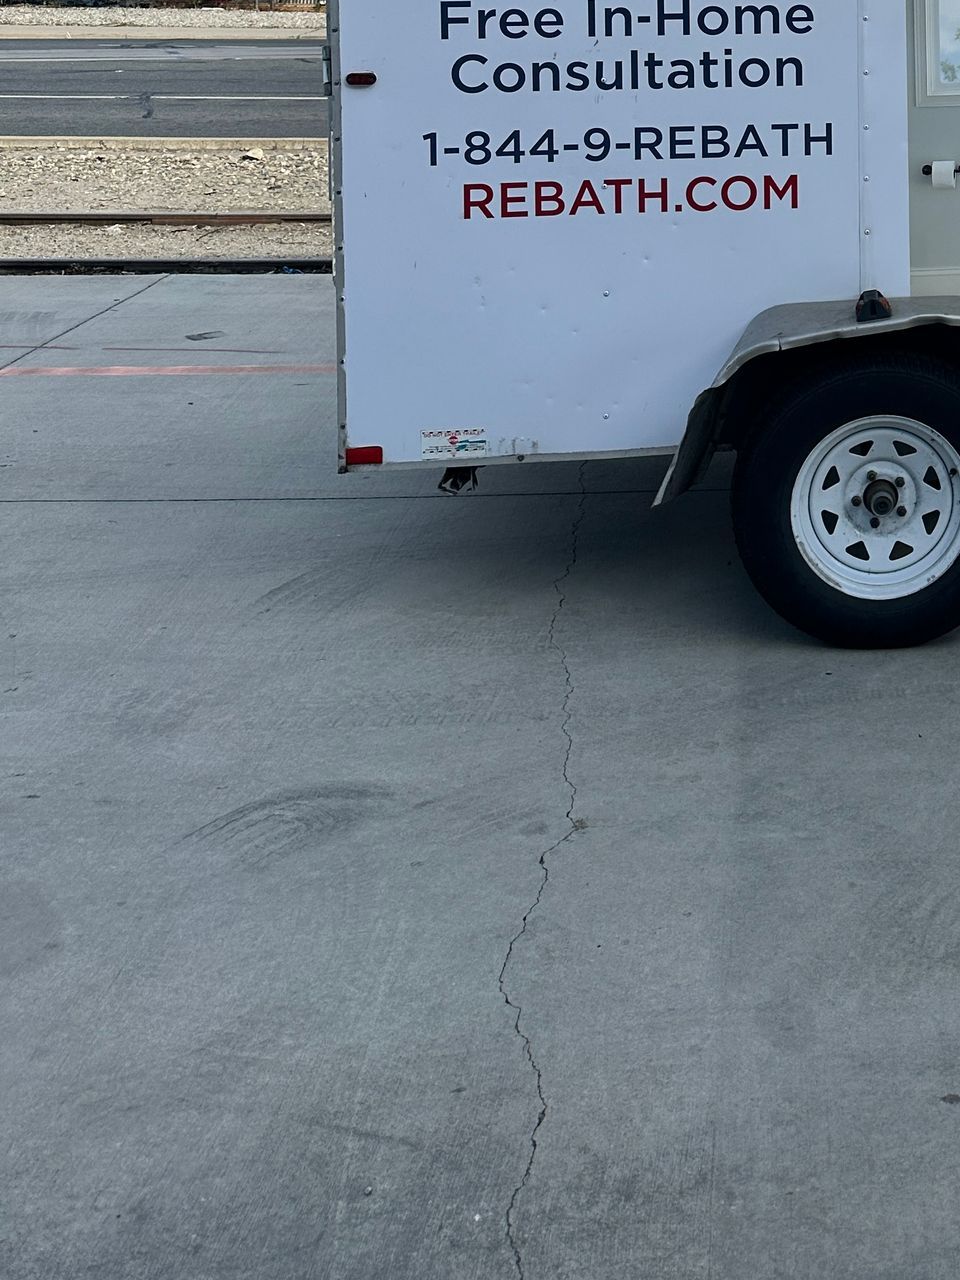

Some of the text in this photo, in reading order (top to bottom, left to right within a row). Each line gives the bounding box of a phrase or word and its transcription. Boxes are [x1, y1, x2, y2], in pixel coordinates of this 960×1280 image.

[439, 0, 564, 40] Free
[451, 48, 803, 94] Consultation
[422, 122, 833, 167] 1-844-9-REBATH
[463, 174, 799, 220] REBATH.COM
